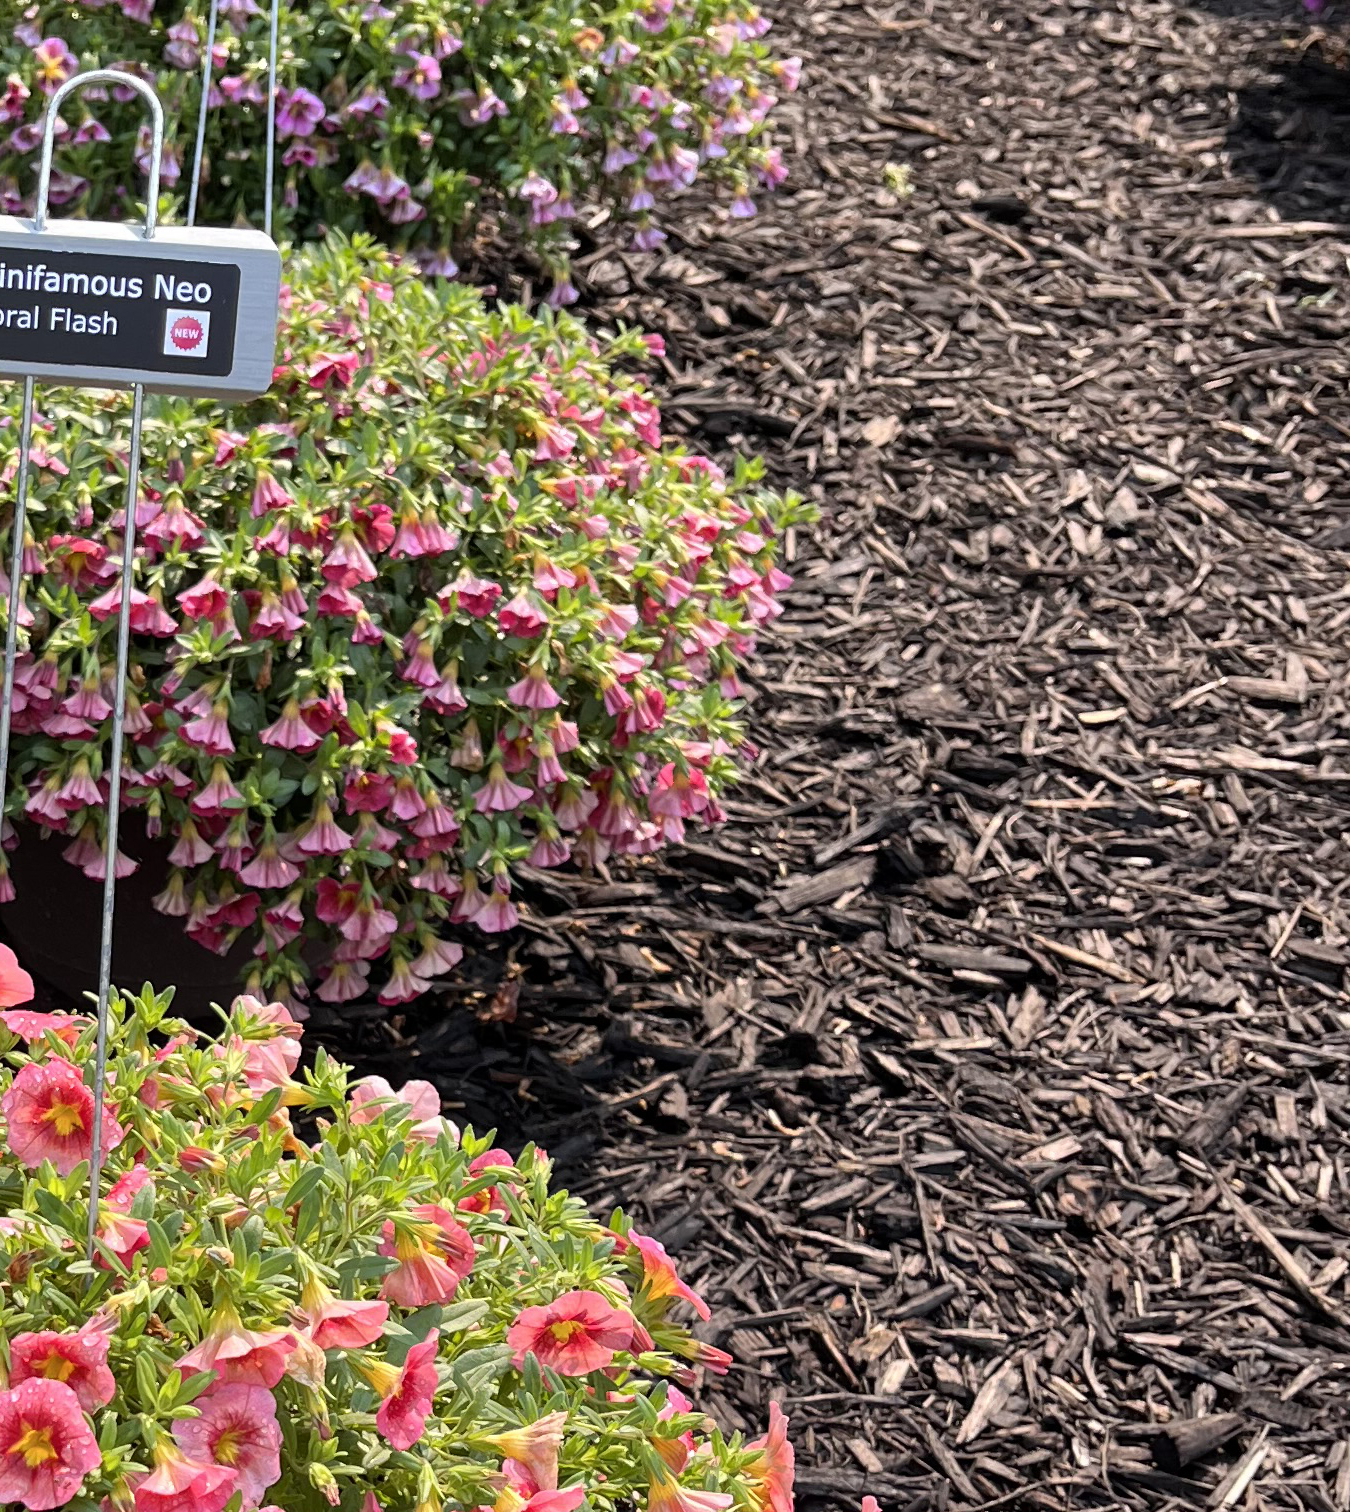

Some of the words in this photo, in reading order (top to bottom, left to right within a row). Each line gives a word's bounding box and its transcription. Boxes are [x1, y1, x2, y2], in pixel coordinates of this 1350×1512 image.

[154, 273, 212, 304] Neo
[50, 307, 118, 336] Flash
[174, 328, 199, 339] NEW
